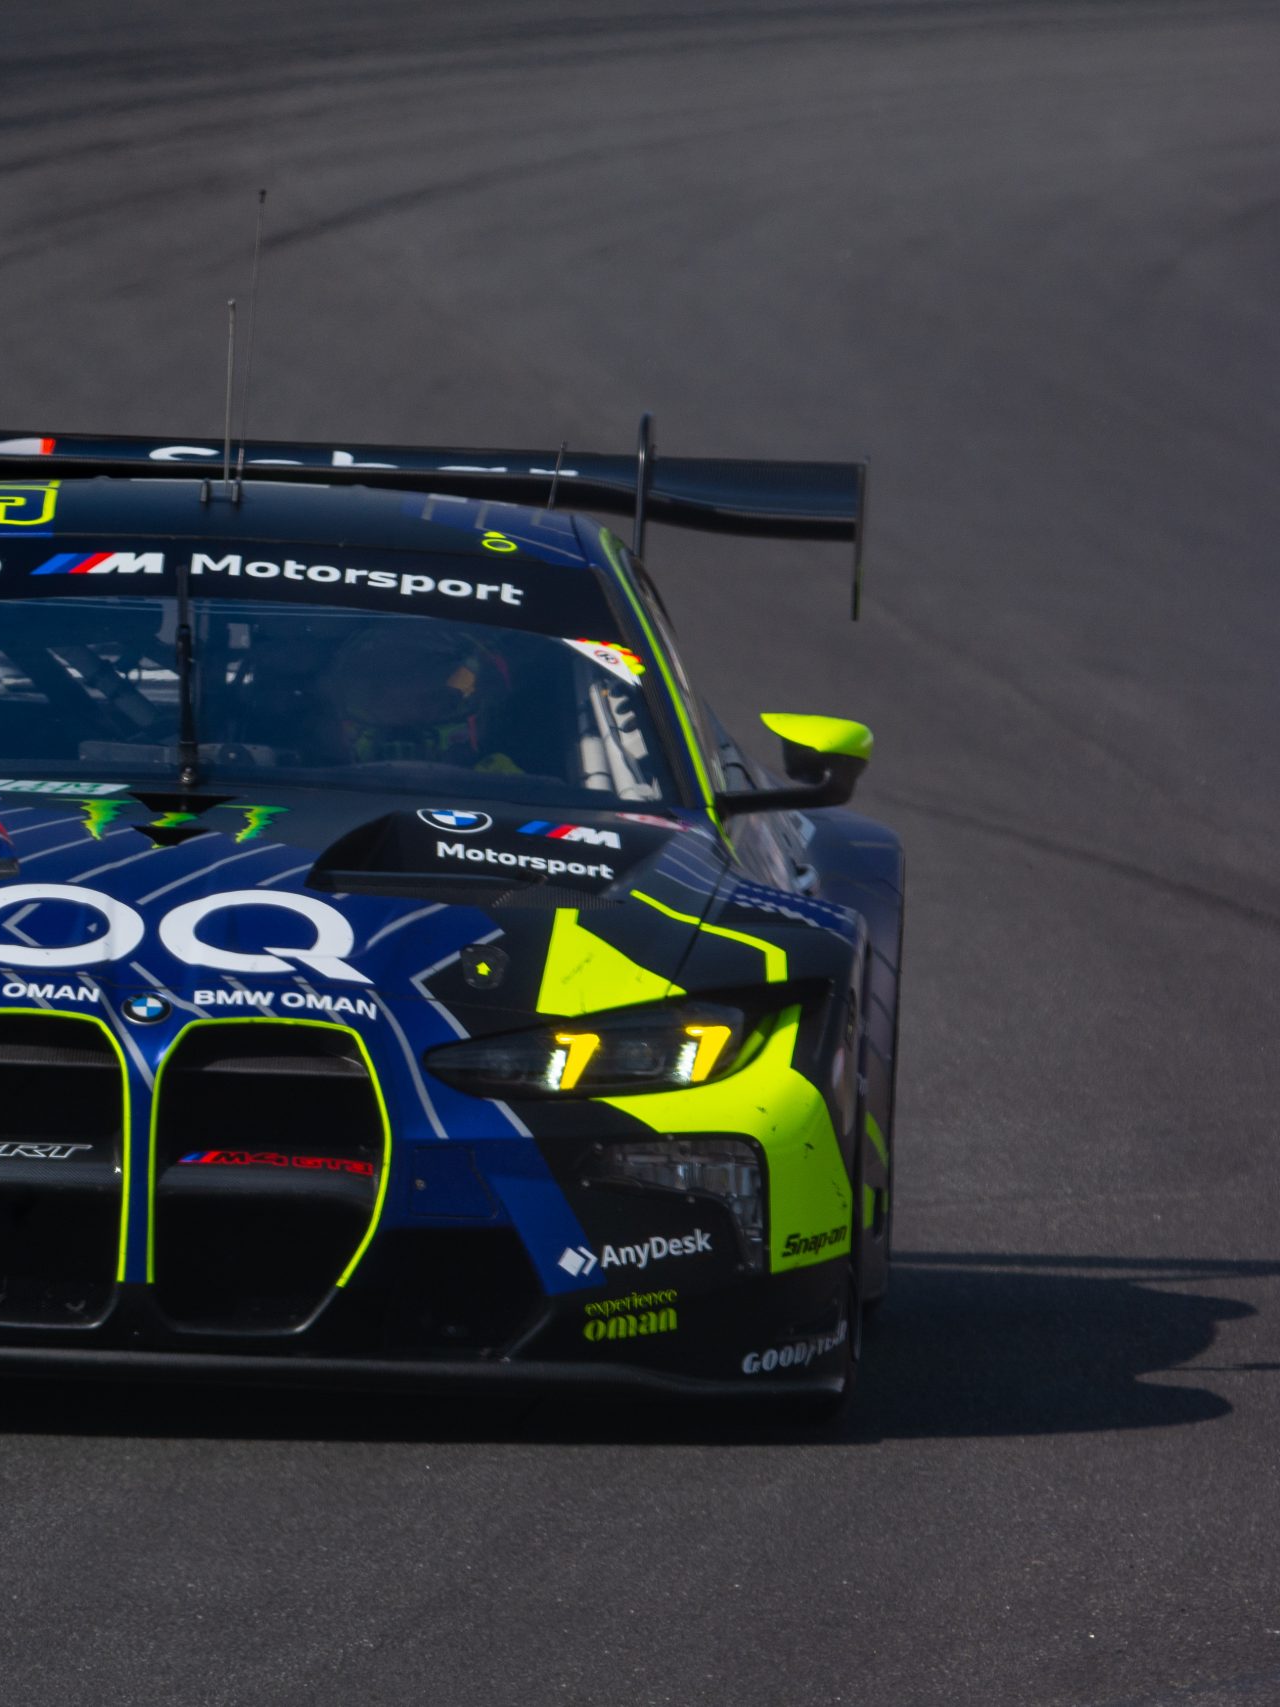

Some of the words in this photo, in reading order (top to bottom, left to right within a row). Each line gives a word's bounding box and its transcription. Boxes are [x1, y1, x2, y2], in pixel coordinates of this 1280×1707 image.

[190, 553, 524, 607] Motorsport
[436, 841, 615, 880] Motorsport
[3, 983, 100, 1003] OMAN
[193, 990, 274, 1008] BMW
[280, 993, 378, 1020] OMAN
[210, 1151, 288, 1167] M4
[600, 1229, 713, 1269] AnyDesk
[782, 1226, 847, 1257] Snap-on
[584, 1289, 678, 1316] experience
[583, 1307, 678, 1342] oman
